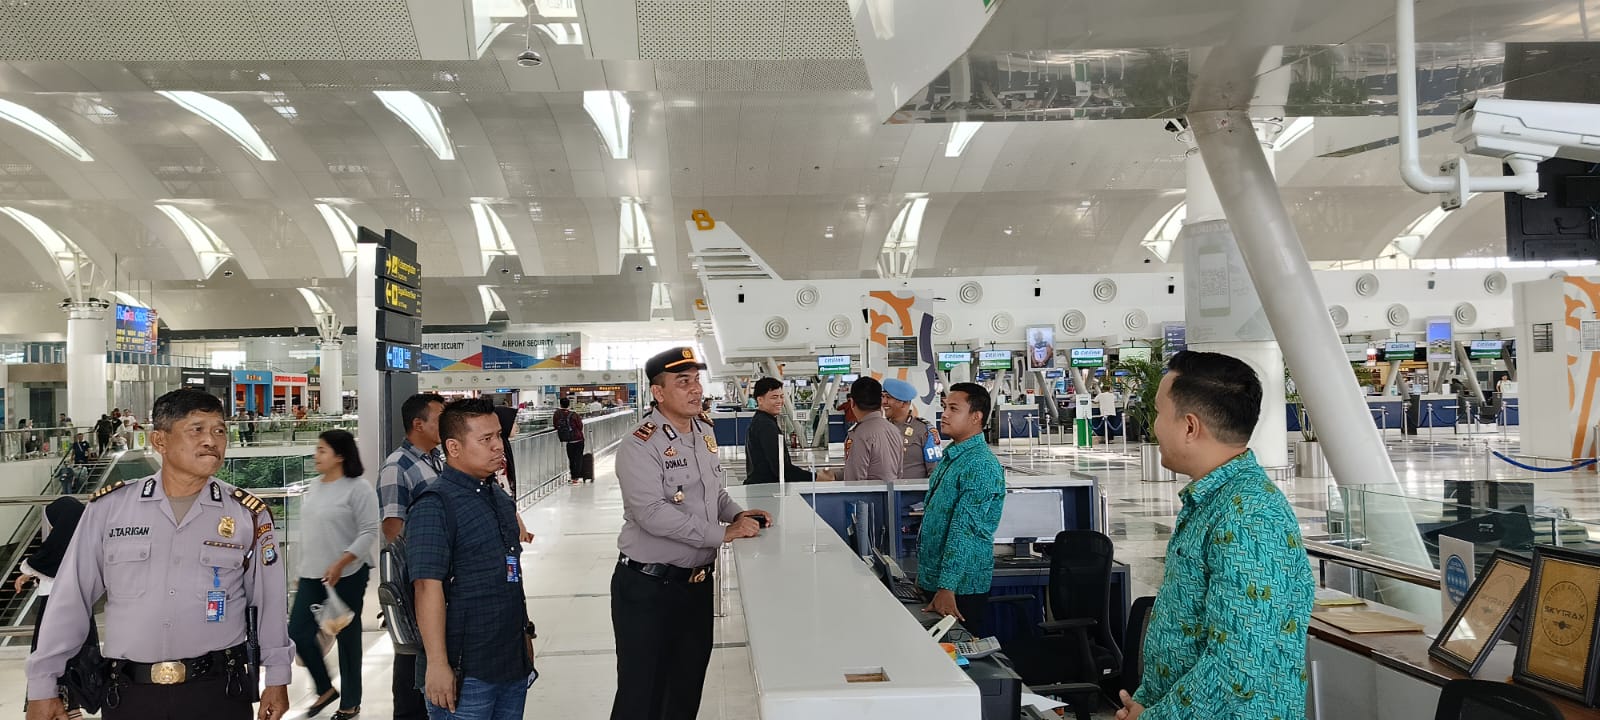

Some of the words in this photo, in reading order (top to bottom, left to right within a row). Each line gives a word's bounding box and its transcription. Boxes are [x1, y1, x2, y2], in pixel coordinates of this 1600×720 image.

[692, 209, 715, 231] B
[421, 342, 440, 350] IRPORT
[441, 342, 465, 350] SECURITY
[502, 339, 526, 347] AIRPORT
[527, 339, 554, 347] SECURITY
[926, 447, 942, 460] PR
[109, 527, 150, 538] J.TARIGAN
[1544, 605, 1585, 621] SKYTRAX
